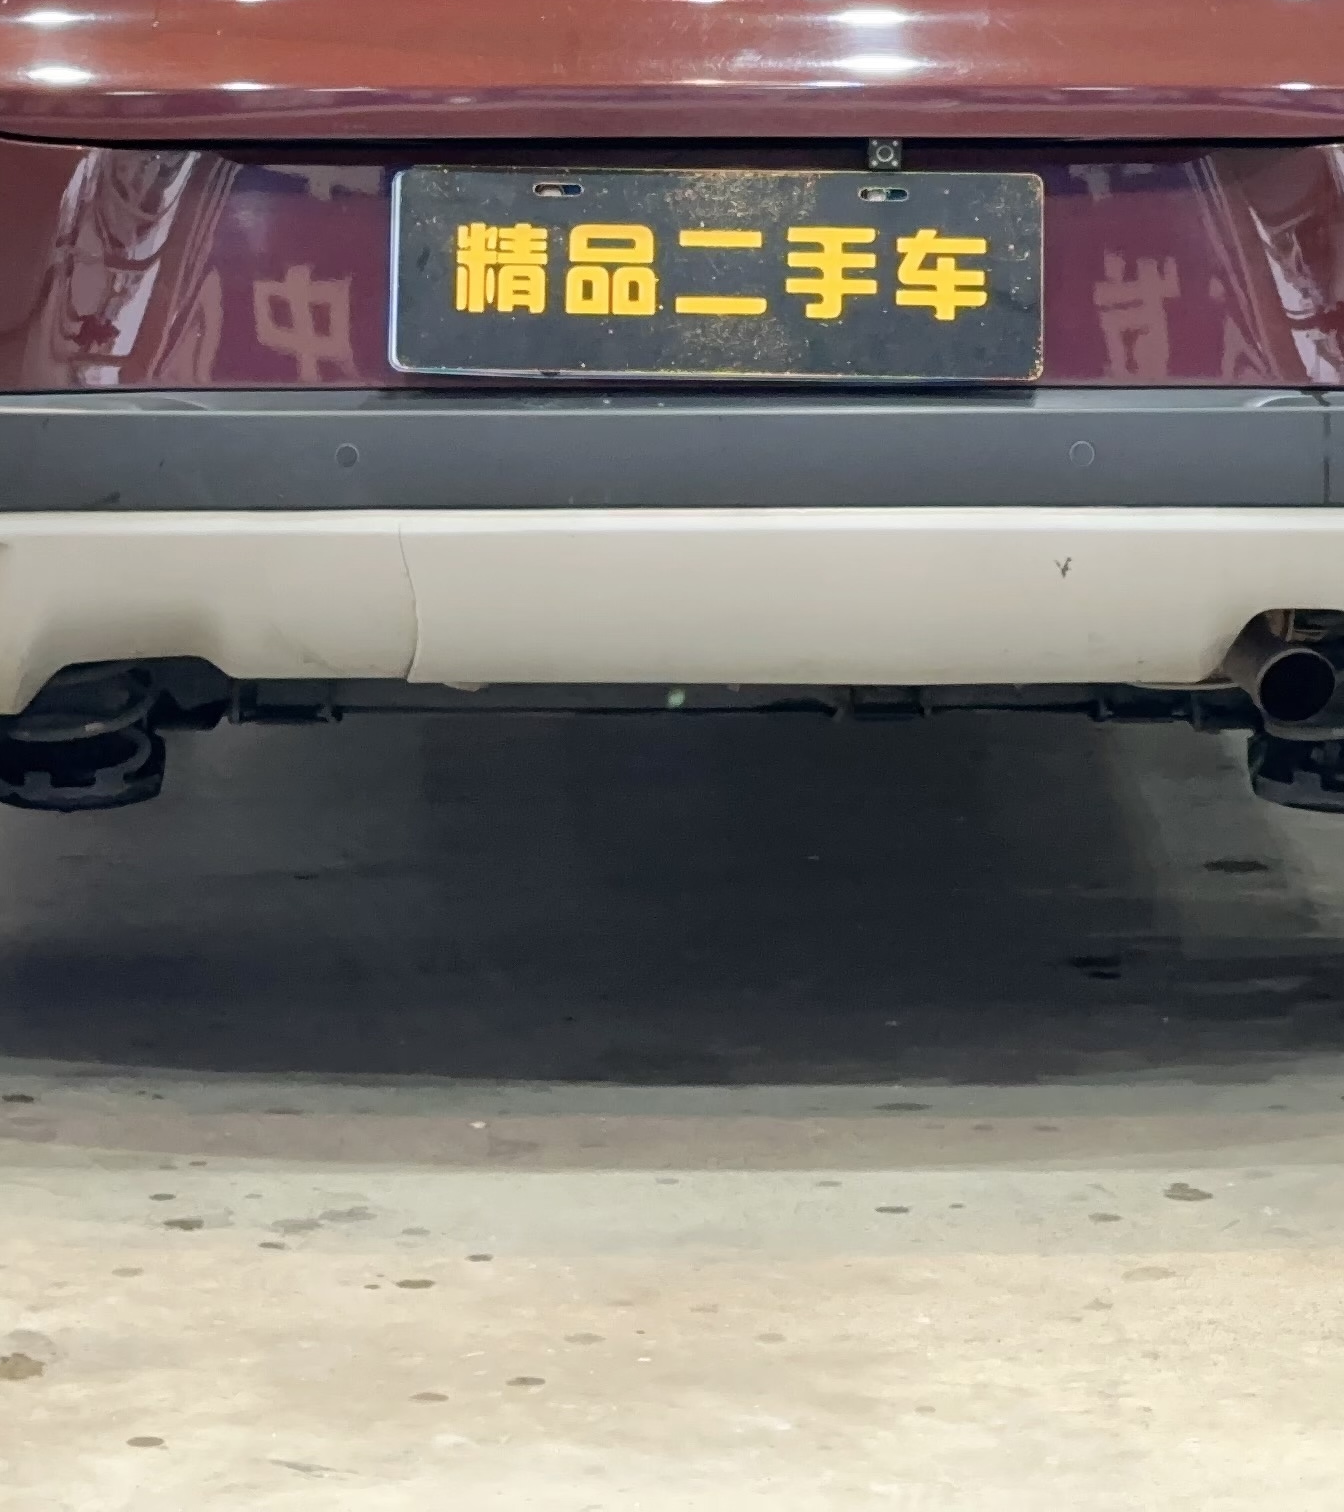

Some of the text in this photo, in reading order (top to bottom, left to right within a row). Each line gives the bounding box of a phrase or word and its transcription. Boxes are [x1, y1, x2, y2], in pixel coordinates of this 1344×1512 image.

[455, 222, 988, 321] 精品二手车
